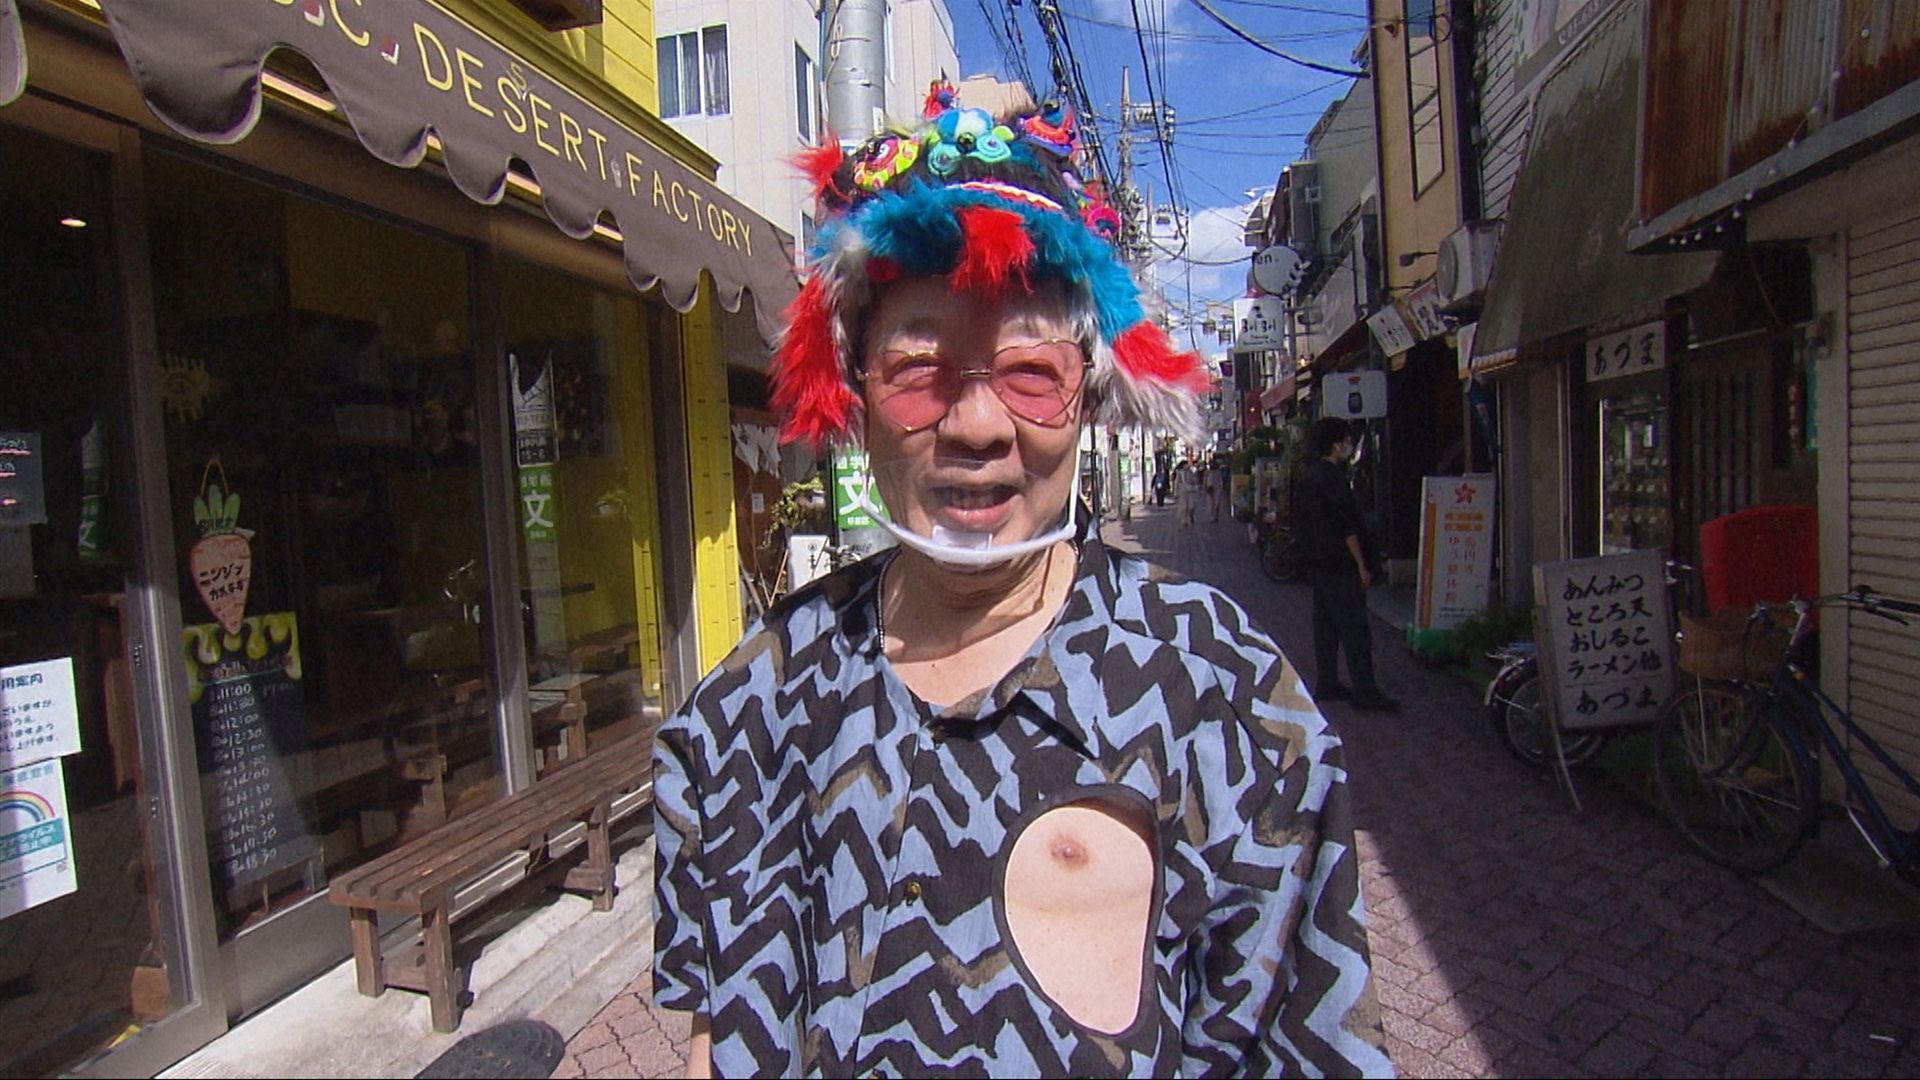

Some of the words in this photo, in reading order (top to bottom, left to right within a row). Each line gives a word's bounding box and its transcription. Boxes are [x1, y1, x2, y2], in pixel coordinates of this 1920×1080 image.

[625, 151, 753, 257] FACTORY
[837, 470, 880, 516] 文
[523, 489, 554, 528] 文
[1562, 574, 1644, 600] あんみつ
[1566, 597, 1652, 627] ところ天
[1570, 626, 1650, 653] おしるこ
[1567, 650, 1662, 680] ラーメン他
